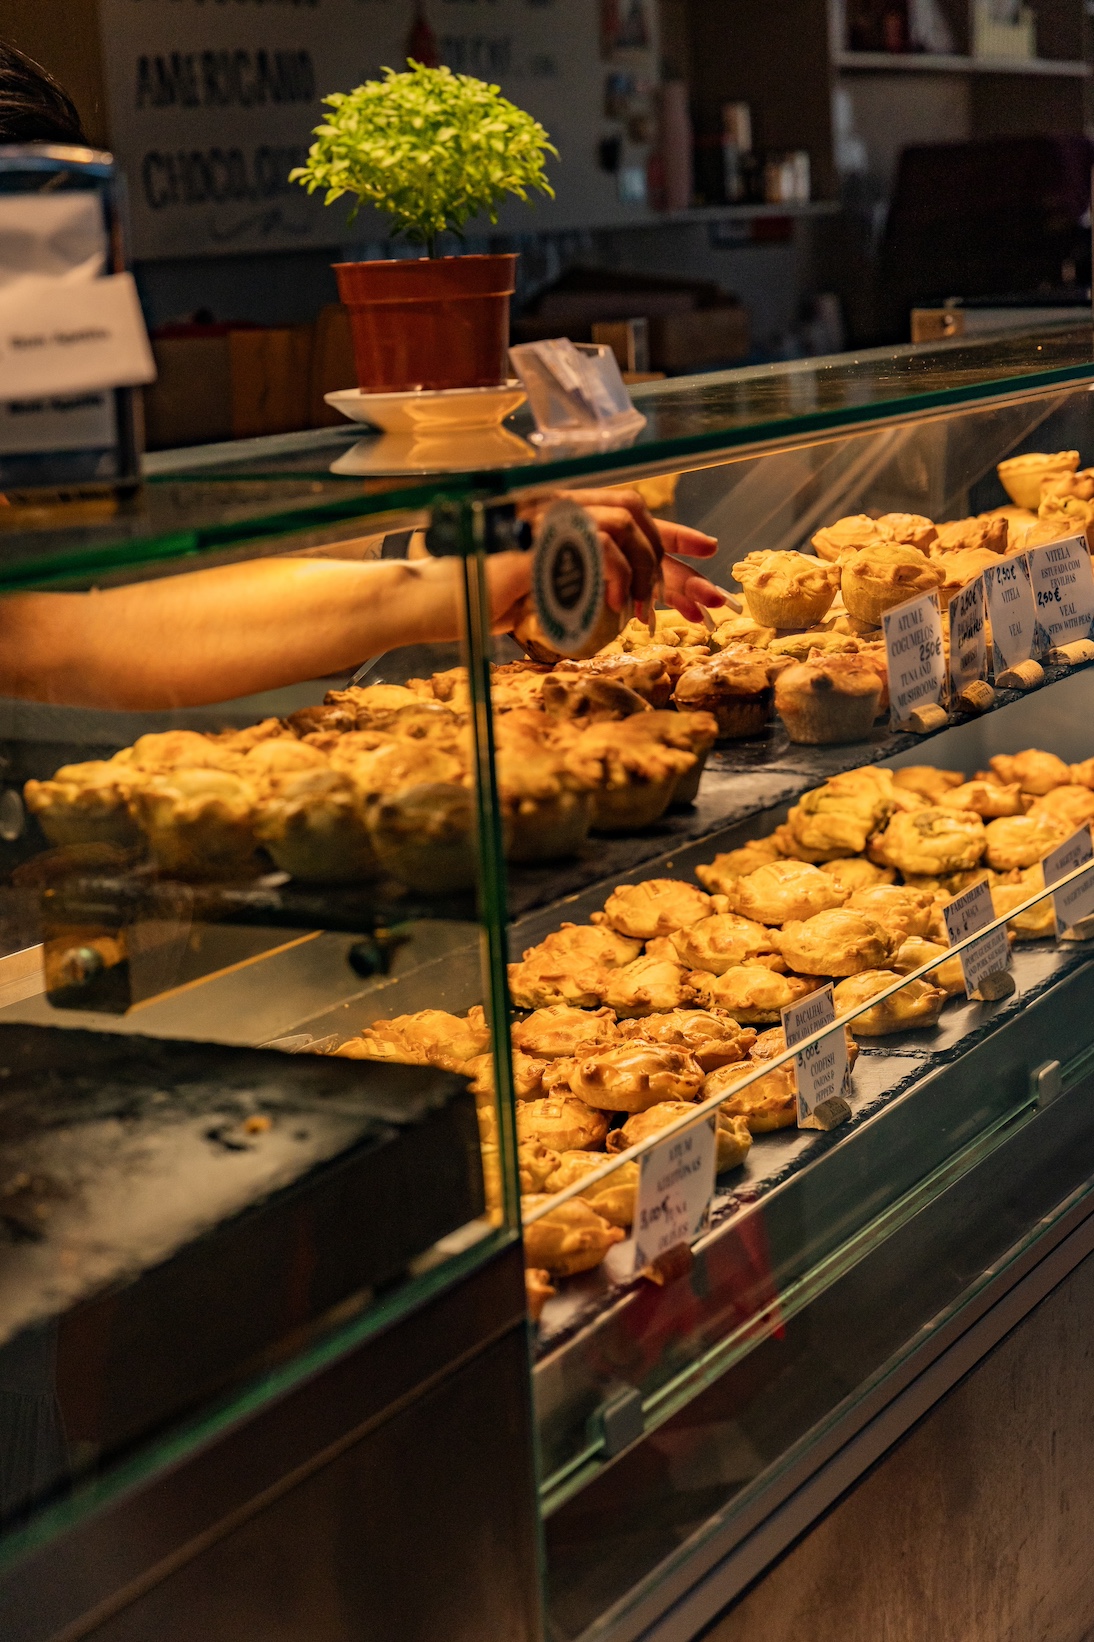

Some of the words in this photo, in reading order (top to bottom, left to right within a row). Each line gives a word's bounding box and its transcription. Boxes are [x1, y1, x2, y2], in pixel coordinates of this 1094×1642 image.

[142, 143, 318, 211] CHOCOLAT
[1045, 547, 1071, 562] VITELA
[1040, 565, 1068, 579] ESTUFADA
[1068, 560, 1081, 570] COM
[1050, 574, 1076, 588] ERVILHAS
[1001, 587, 1020, 603] VITELA
[1037, 587, 1061, 608] 2,50€
[1059, 603, 1077, 617] VEAL
[1008, 622, 1022, 637] VEAL
[1048, 622, 1063, 635] STEW
[1063, 618, 1079, 630] WITH
[1079, 613, 1091, 625] PEAS
[891, 624, 934, 657] COGUMELOS
[901, 669, 918, 687] TUNA
[919, 661, 931, 676] AND
[897, 676, 937, 706] MUSHROOMS
[795, 1000, 824, 1027] BACALHAU
[810, 1052, 835, 1077] CODFISH
[813, 1073, 830, 1090] ONIONS
